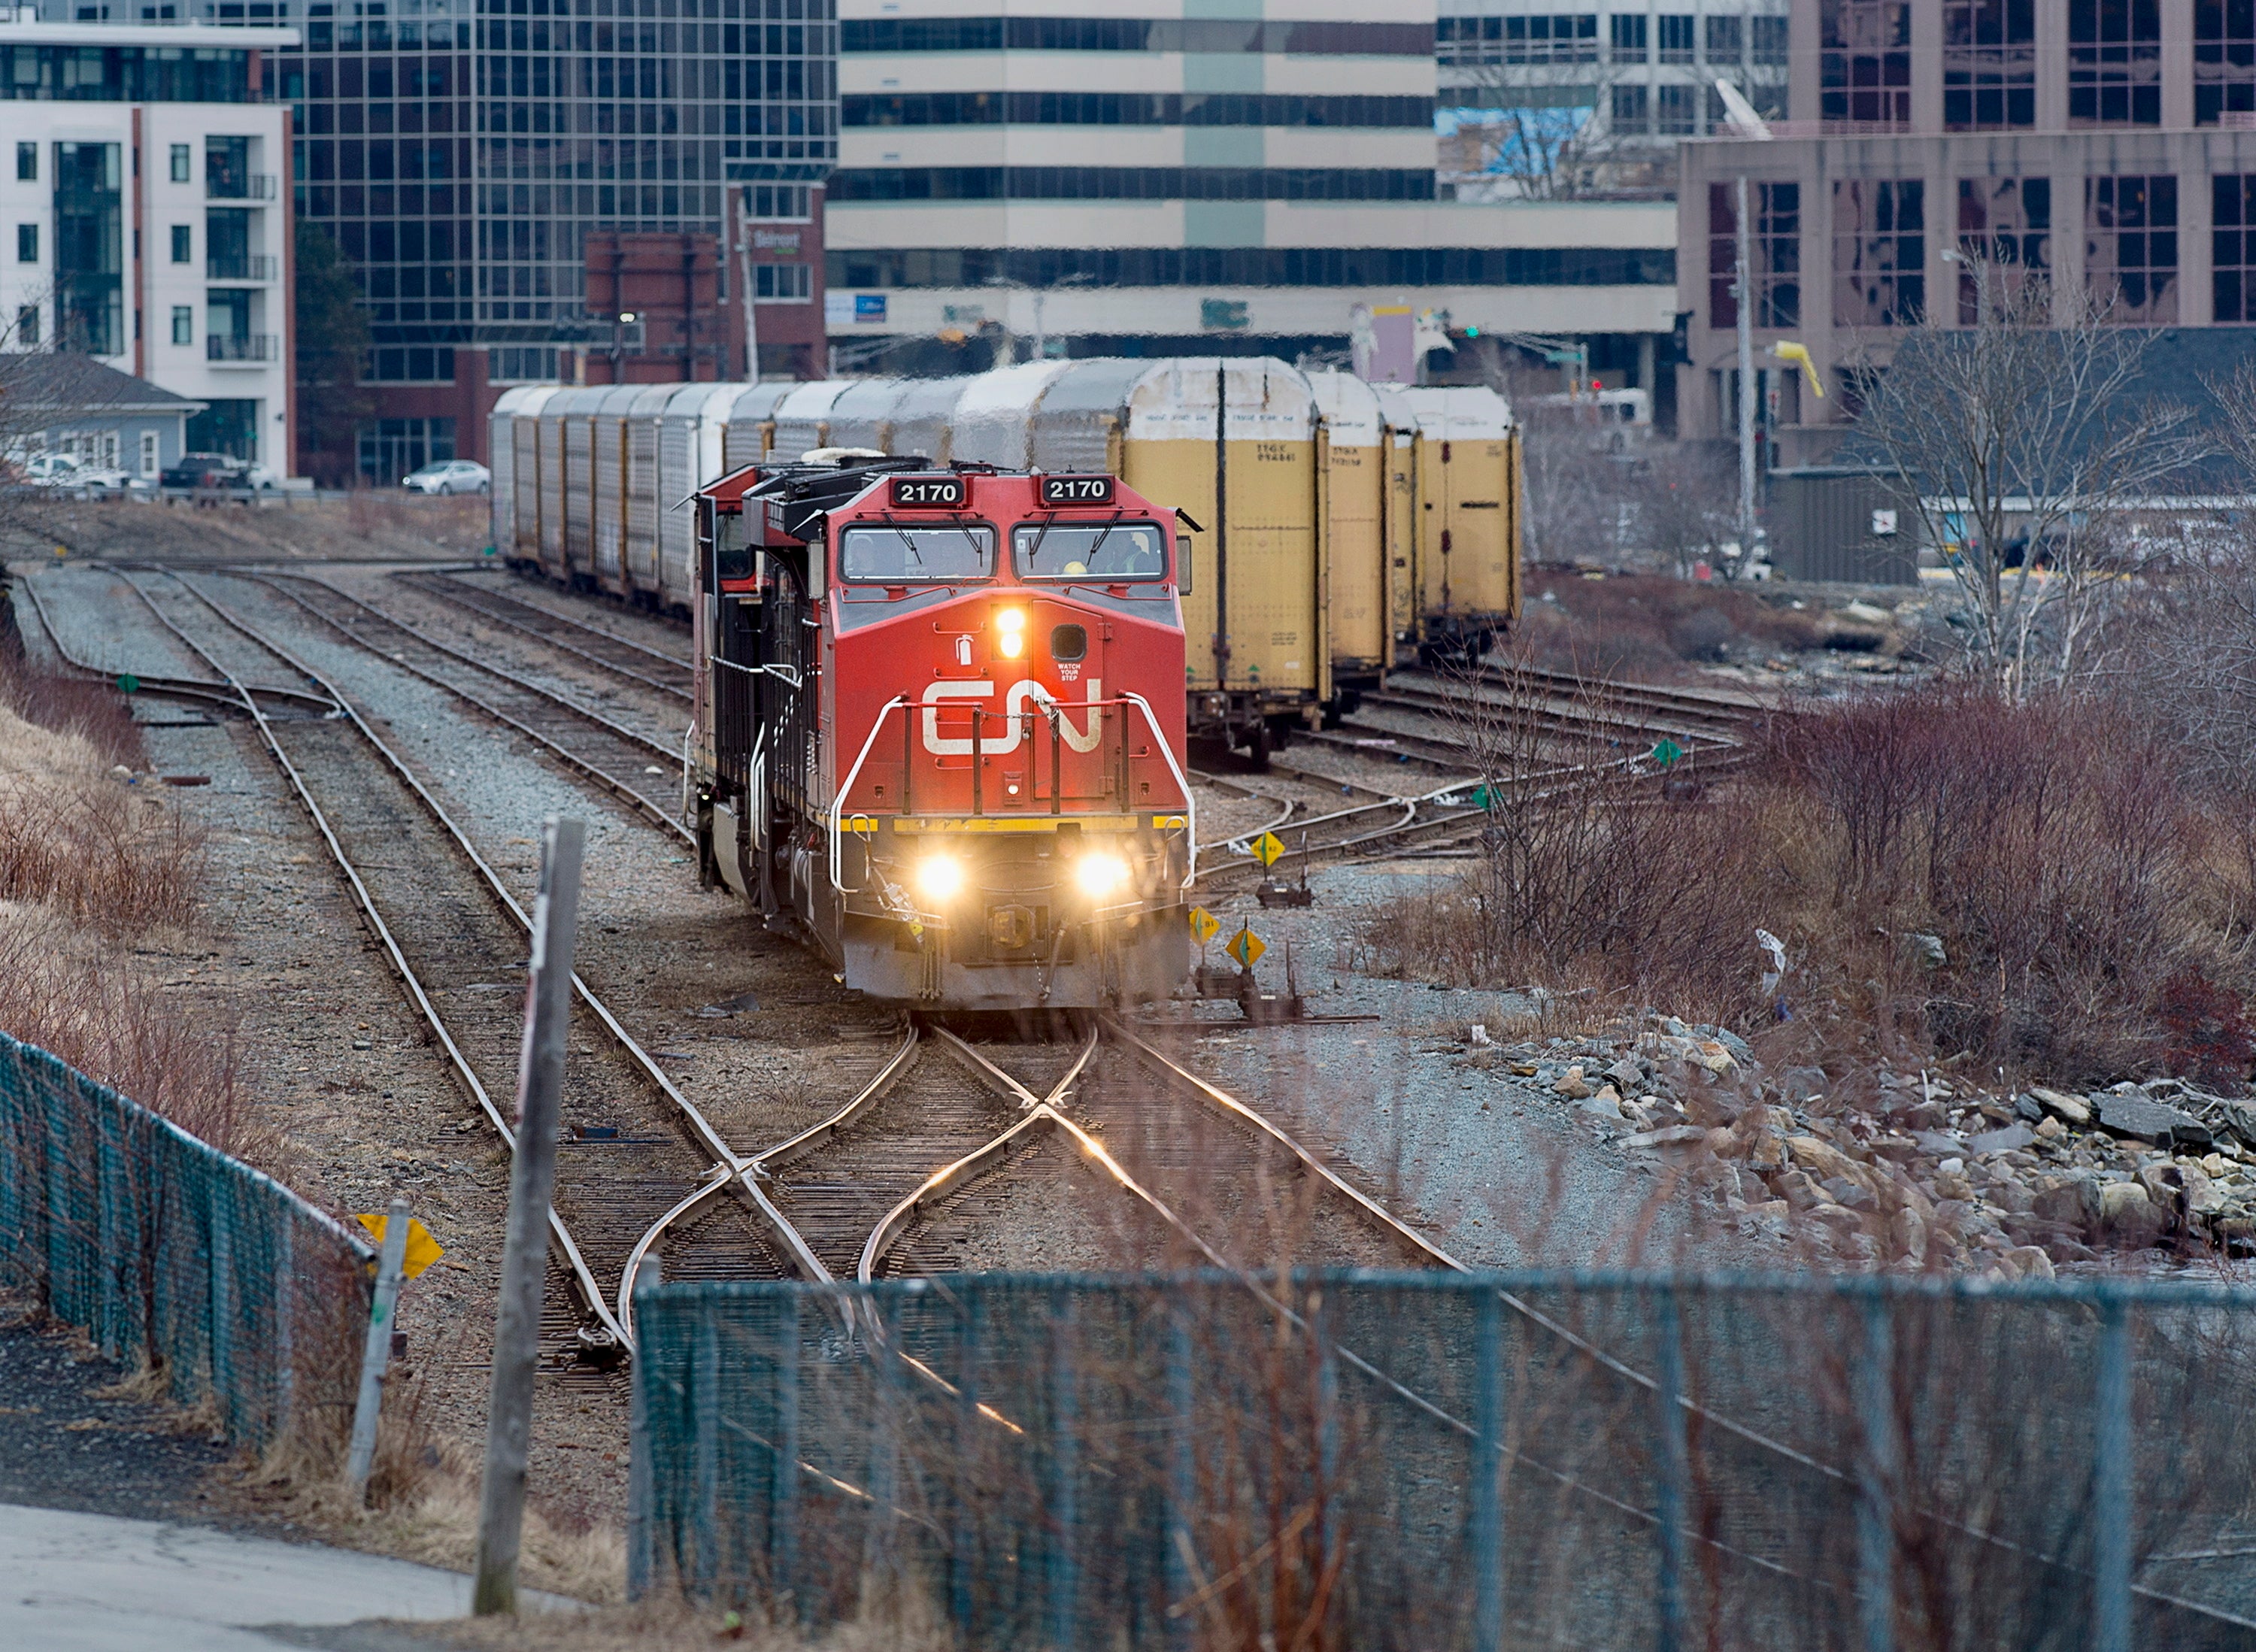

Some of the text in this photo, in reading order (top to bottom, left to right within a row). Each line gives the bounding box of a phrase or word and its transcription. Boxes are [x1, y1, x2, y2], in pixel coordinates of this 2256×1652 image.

[901, 484, 957, 502] 2170
[1050, 480, 1105, 498] 2170
[922, 678, 1102, 755] CN
